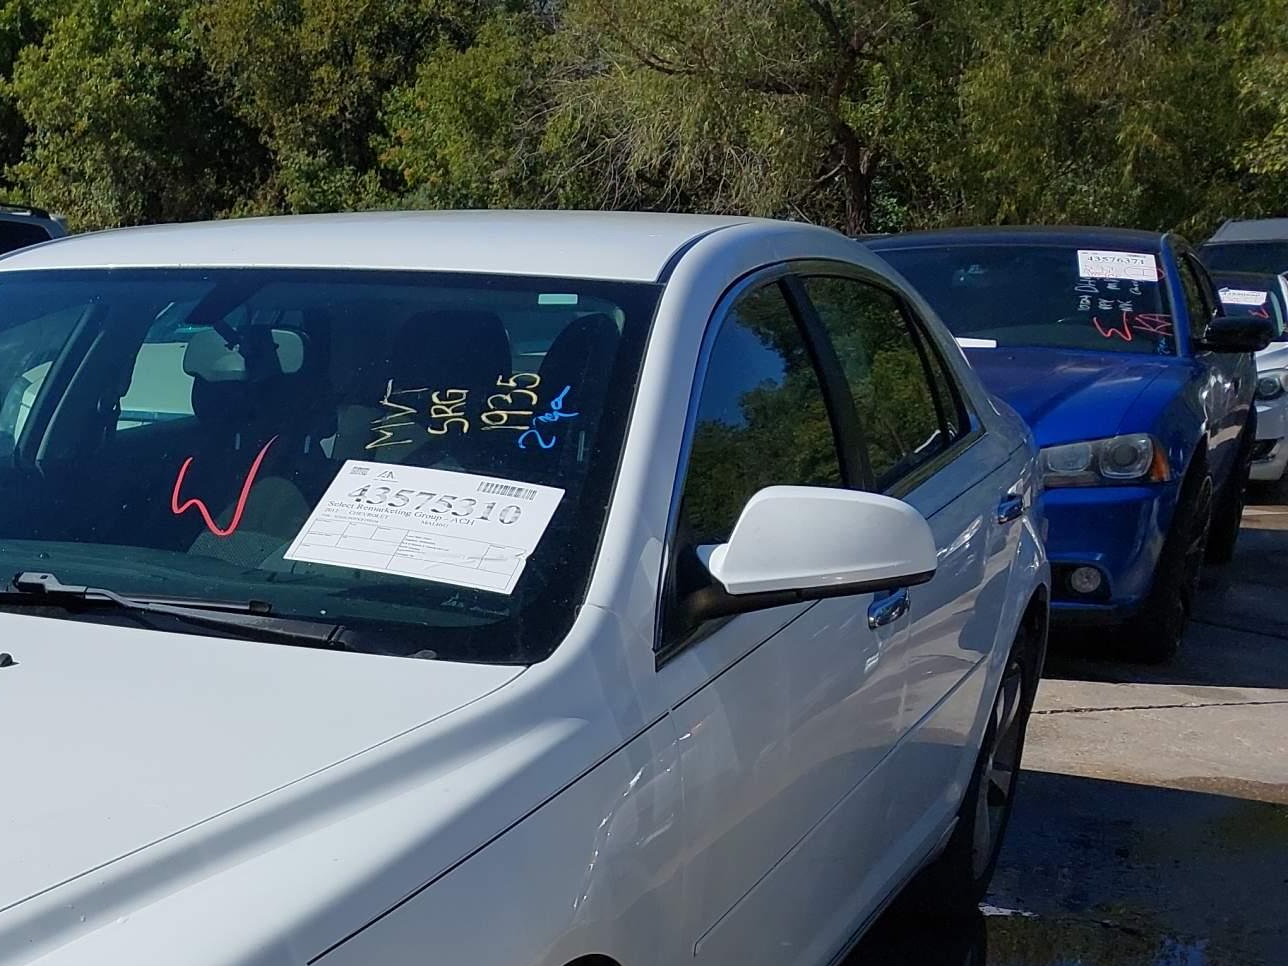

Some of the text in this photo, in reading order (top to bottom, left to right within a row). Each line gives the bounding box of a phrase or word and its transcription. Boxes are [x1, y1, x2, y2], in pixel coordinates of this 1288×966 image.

[481, 373, 540, 431] 1935
[327, 500, 354, 510] Select
[356, 503, 412, 517] Remarketing
[414, 511, 443, 522] Group
[450, 517, 476, 527] ACH
[348, 484, 522, 525] 43575310
